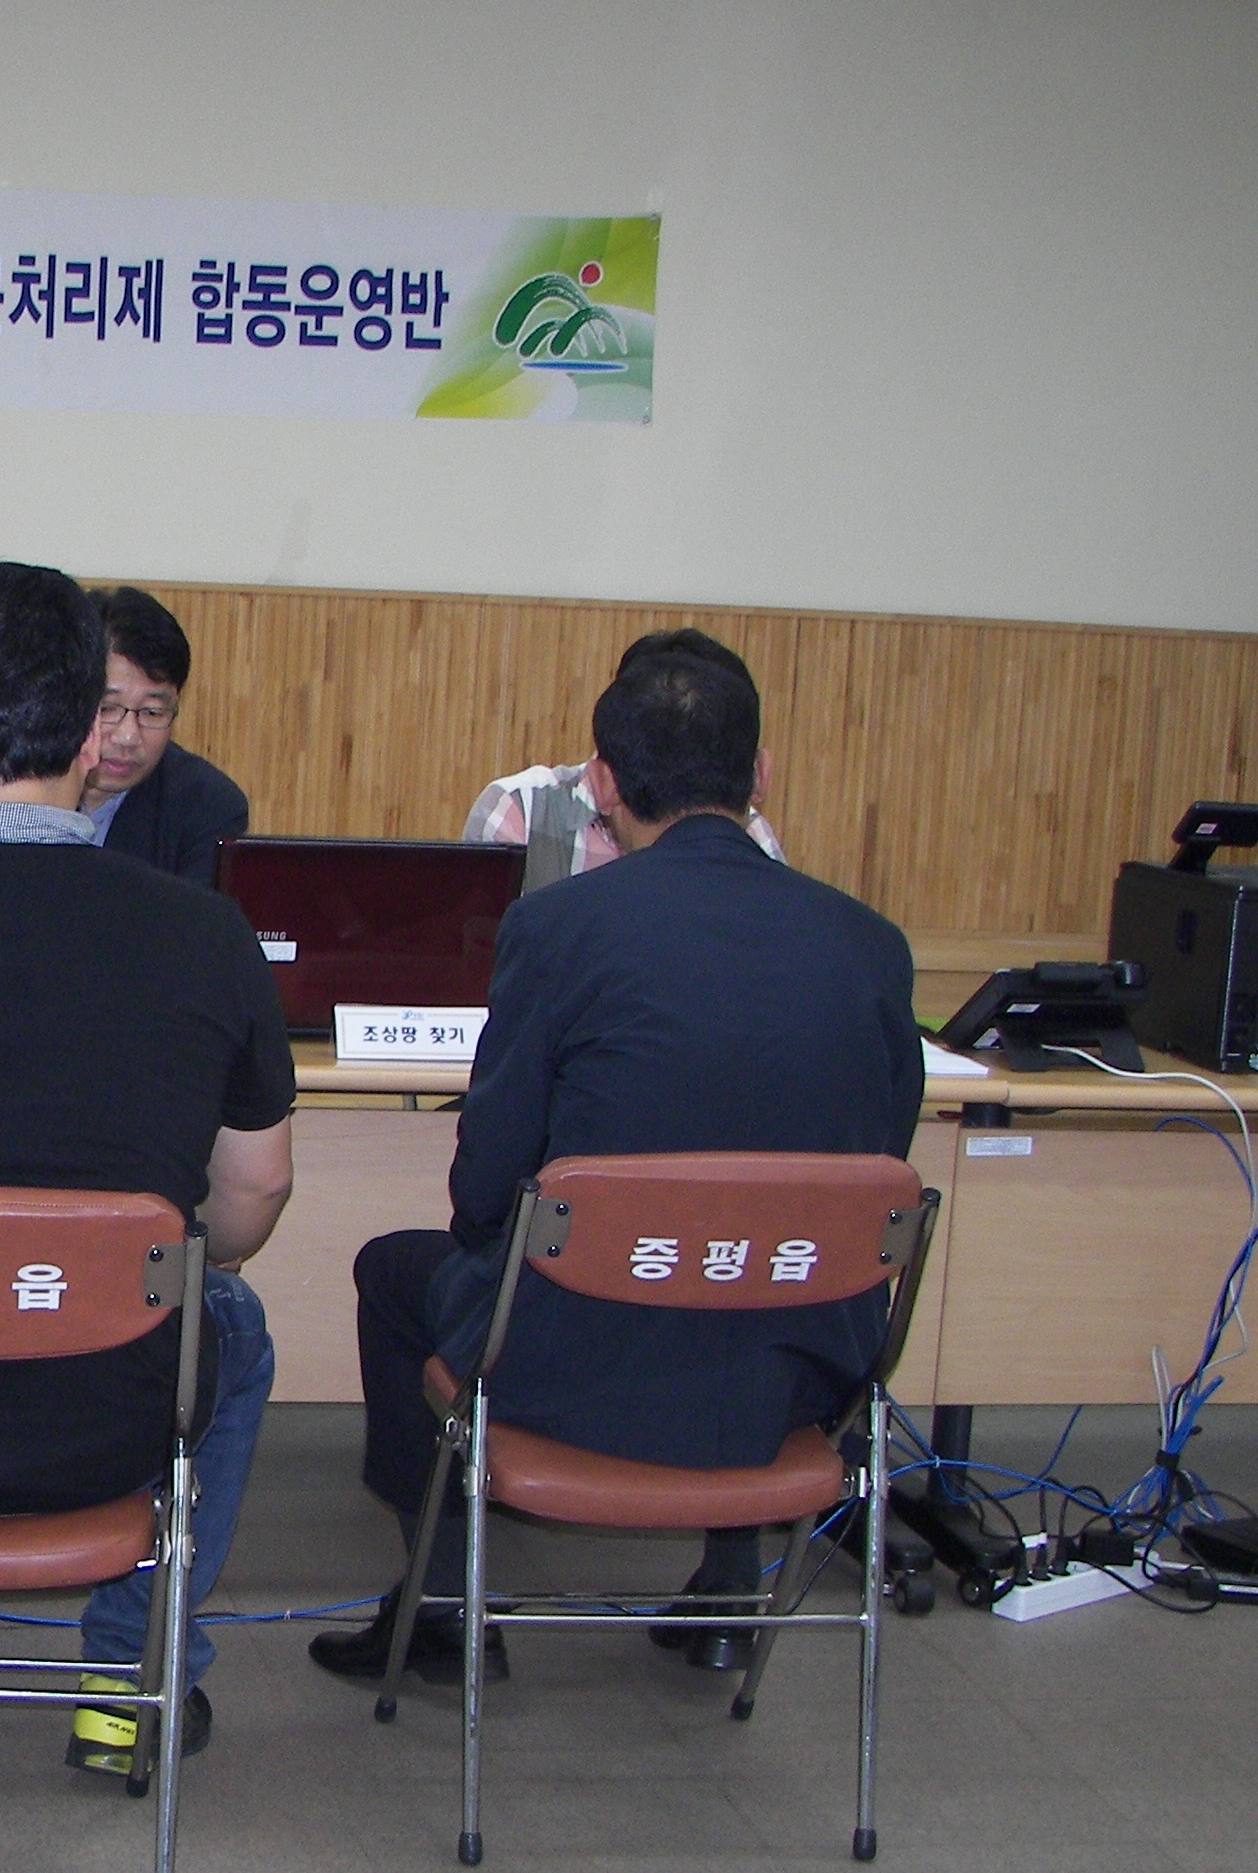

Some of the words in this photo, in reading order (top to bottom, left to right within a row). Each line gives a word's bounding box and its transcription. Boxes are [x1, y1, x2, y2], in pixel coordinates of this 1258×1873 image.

[191, 259, 449, 350] 합동운영반
[362, 1025, 419, 1044] 조상땅
[429, 1026, 465, 1044] 찾기
